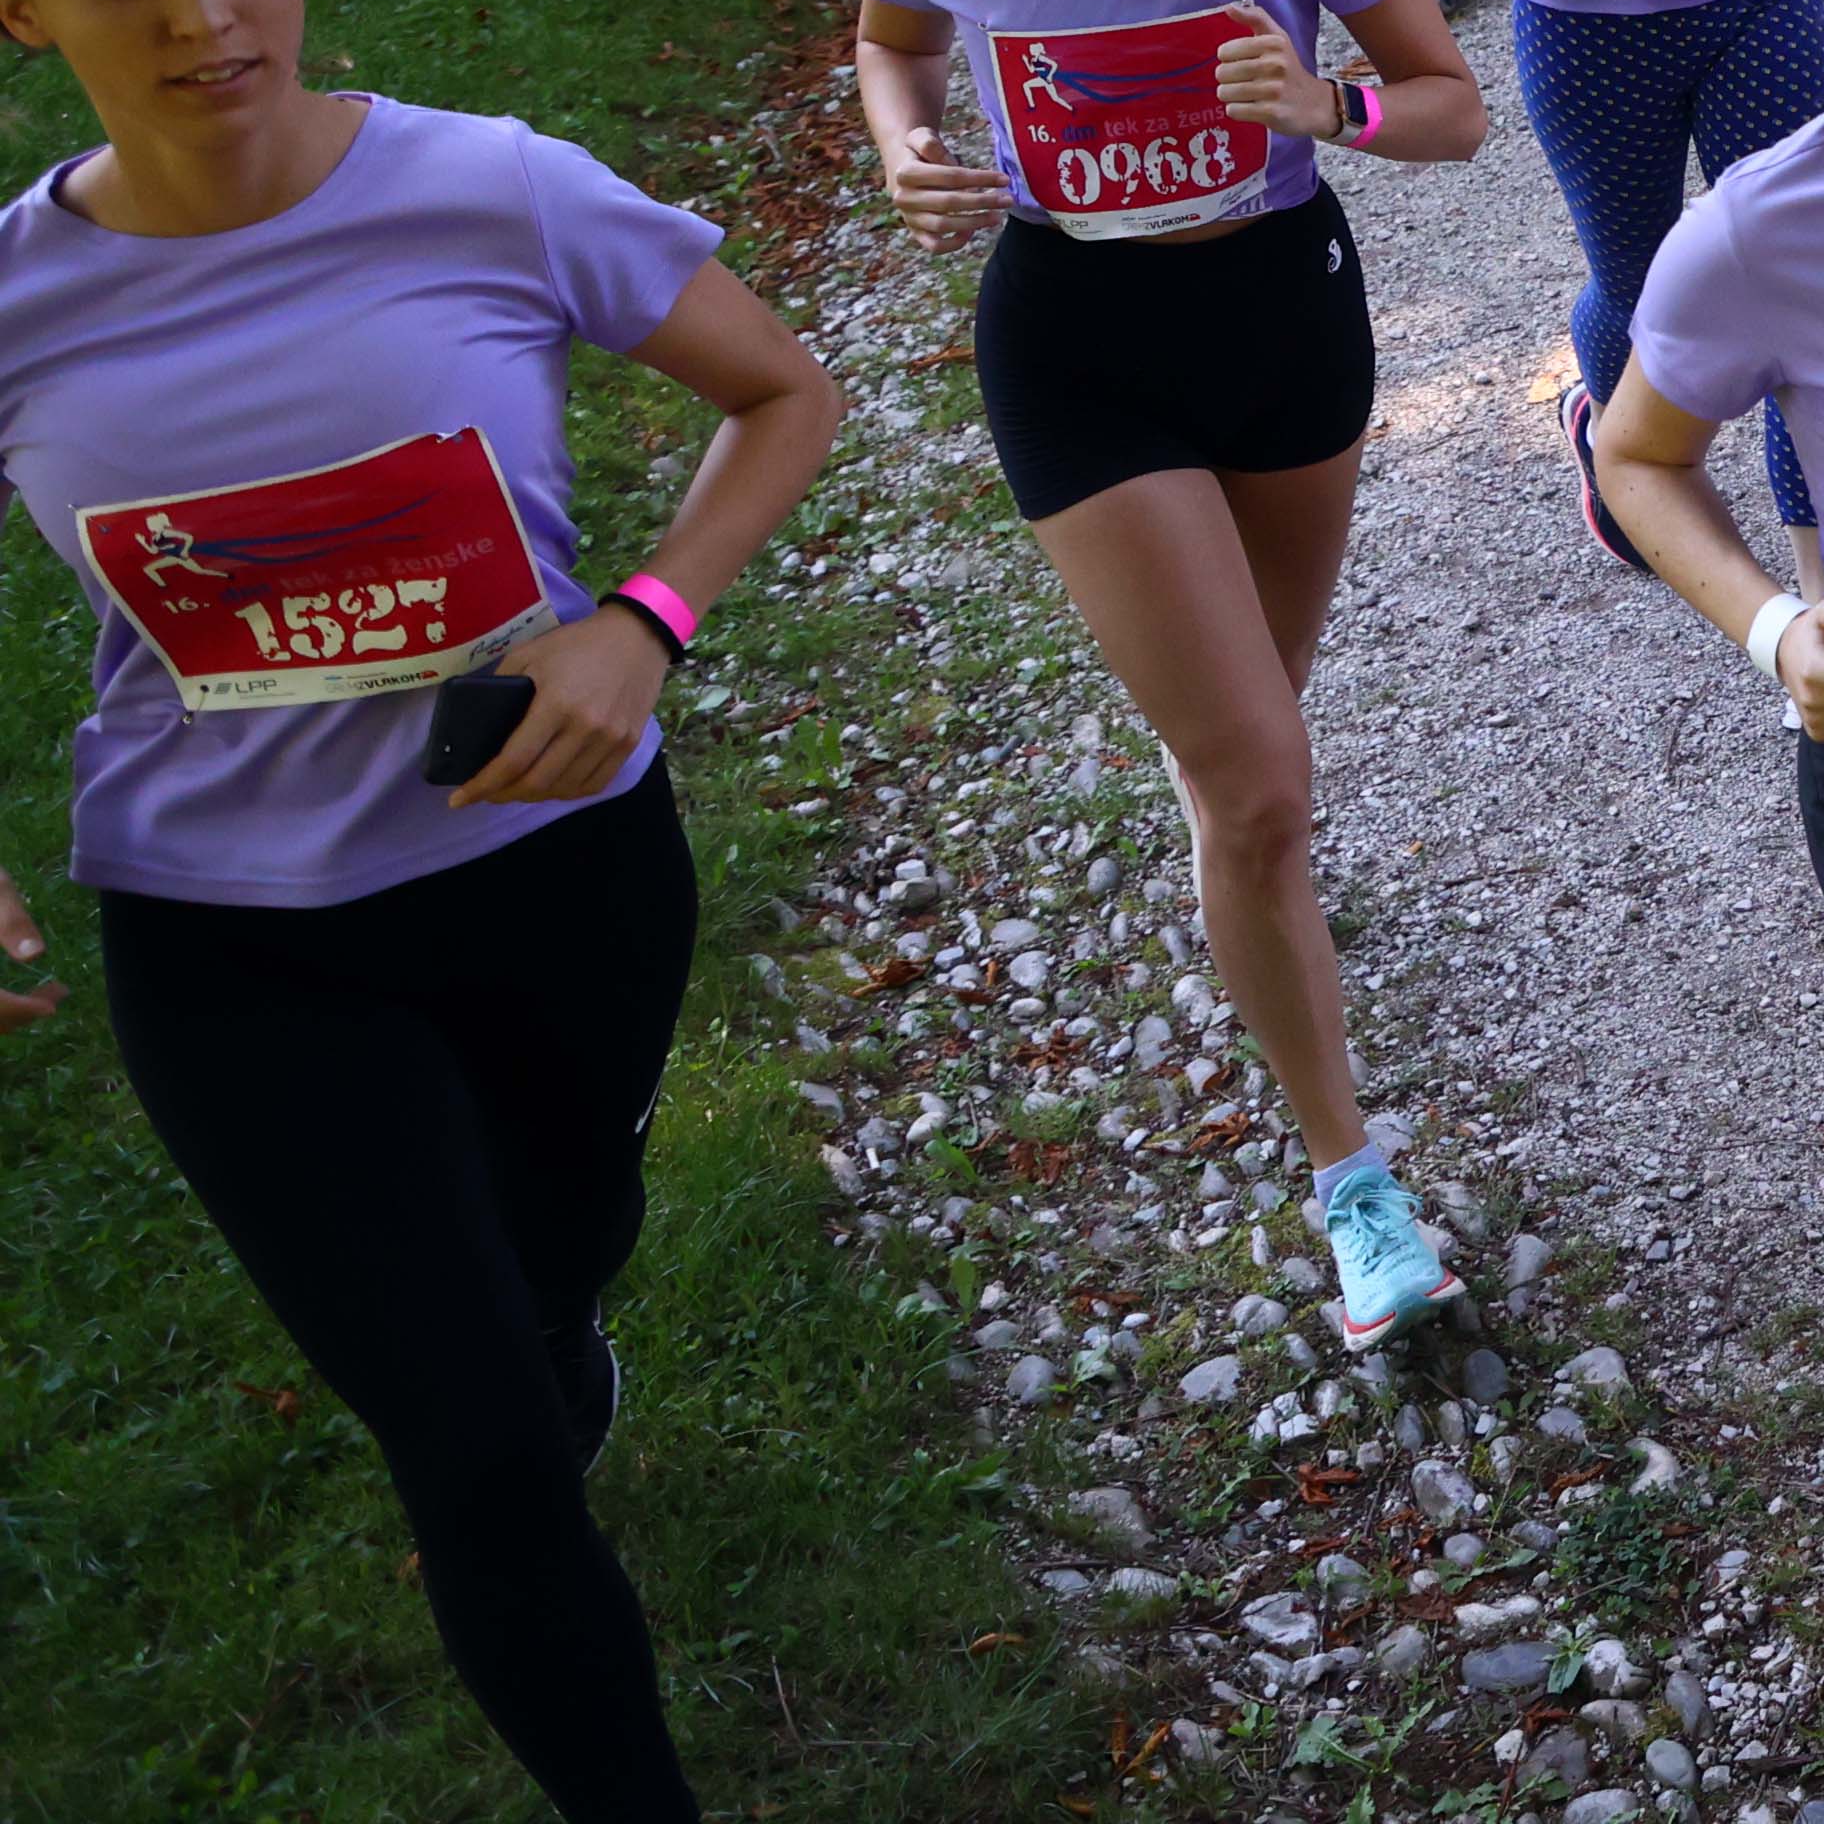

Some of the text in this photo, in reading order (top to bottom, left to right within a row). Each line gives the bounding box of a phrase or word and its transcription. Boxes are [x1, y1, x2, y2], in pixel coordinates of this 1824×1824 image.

[1027, 125, 1057, 143] 16.
[1104, 117, 1138, 137] tek
[1145, 117, 1169, 133] za
[1177, 105, 1227, 129] žens
[1057, 126, 1235, 205] 0968
[162, 596, 210, 614] 16.
[391, 536, 495, 573] ženske
[234, 577, 447, 661] 1527
[235, 679, 277, 694] LPP
